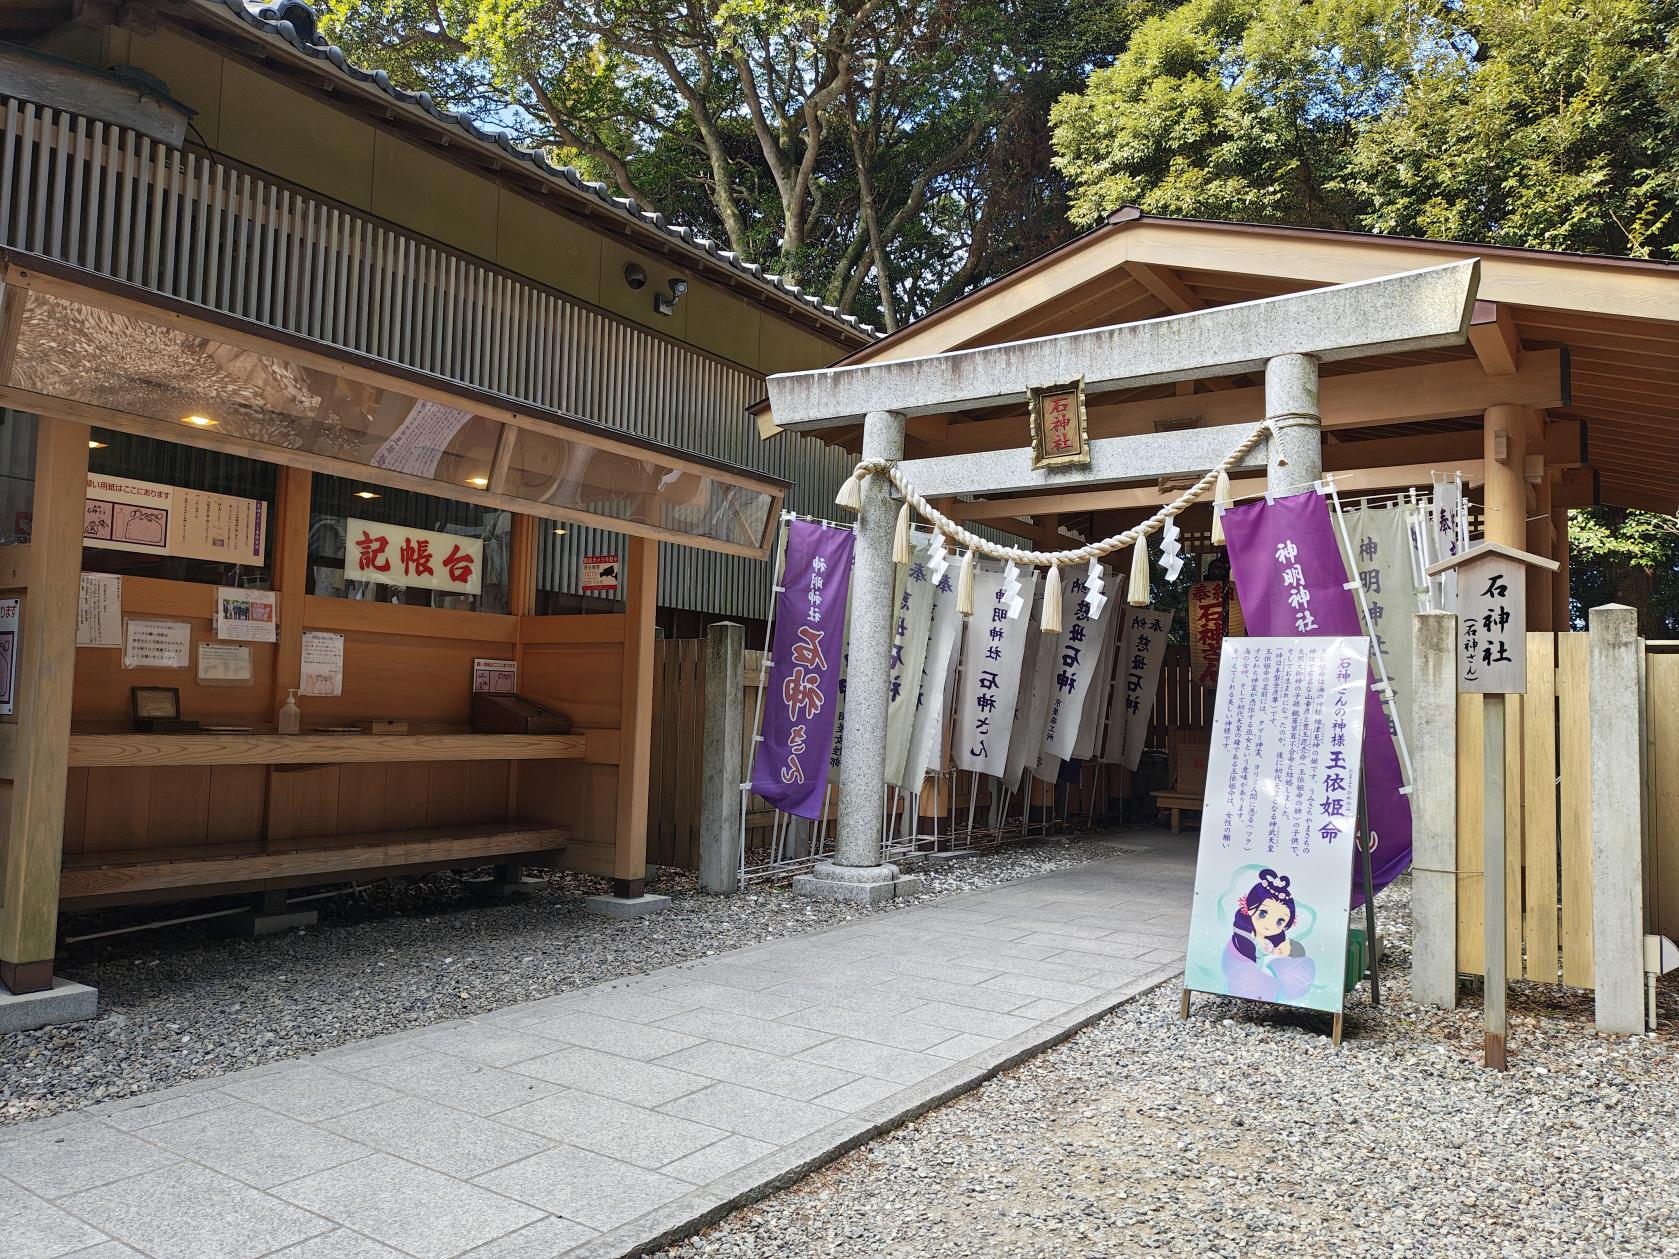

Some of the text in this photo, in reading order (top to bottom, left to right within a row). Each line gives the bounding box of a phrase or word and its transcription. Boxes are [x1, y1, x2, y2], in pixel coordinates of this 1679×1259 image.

[1049, 395, 1073, 451] 石神社
[355, 530, 475, 584] 記帳台
[1274, 539, 1319, 634] 神明神社
[1480, 574, 1512, 667] 石神社
